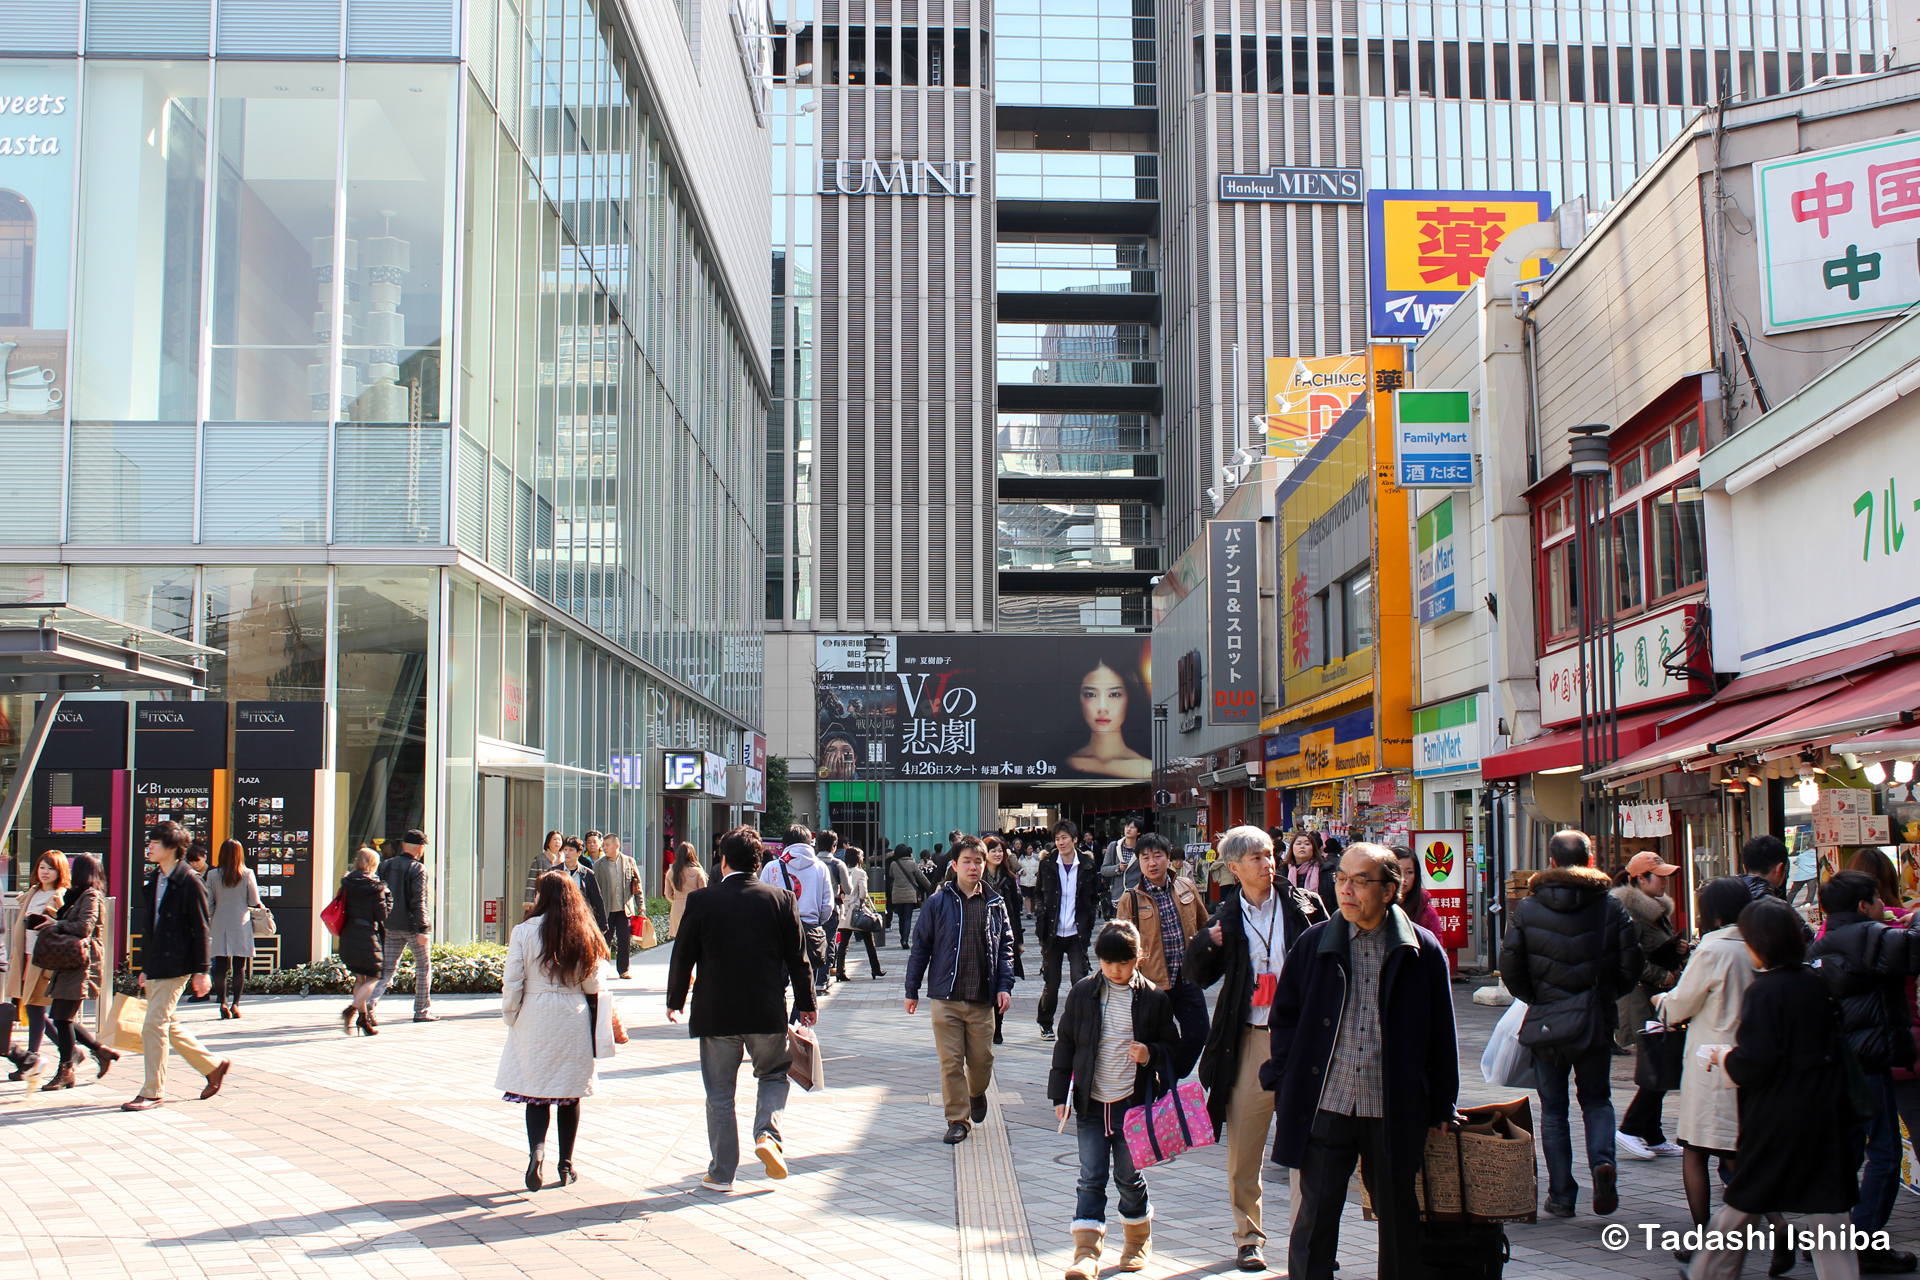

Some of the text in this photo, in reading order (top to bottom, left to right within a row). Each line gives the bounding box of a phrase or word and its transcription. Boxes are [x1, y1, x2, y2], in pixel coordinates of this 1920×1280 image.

[816, 159, 977, 196] LUMINE
[1226, 180, 1274, 198] Hankyu
[1417, 207, 1506, 286] 薬
[1376, 369, 1402, 393] 薬
[1404, 432, 1467, 445] FamilyMart
[1406, 465, 1468, 481] 酒 たばこ
[1419, 544, 1454, 584] FamilyMart
[1215, 690, 1256, 706] DUO
[1223, 709, 1248, 717] デュオ
[901, 718, 976, 755] 悲劇
[1423, 731, 1462, 763] FamilyMart
[150, 782, 161, 793] B1
[247, 797, 258, 806] 4F
[247, 814, 258, 823] 3F
[247, 831, 258, 839] 2F
[247, 847, 257, 856] 1F
